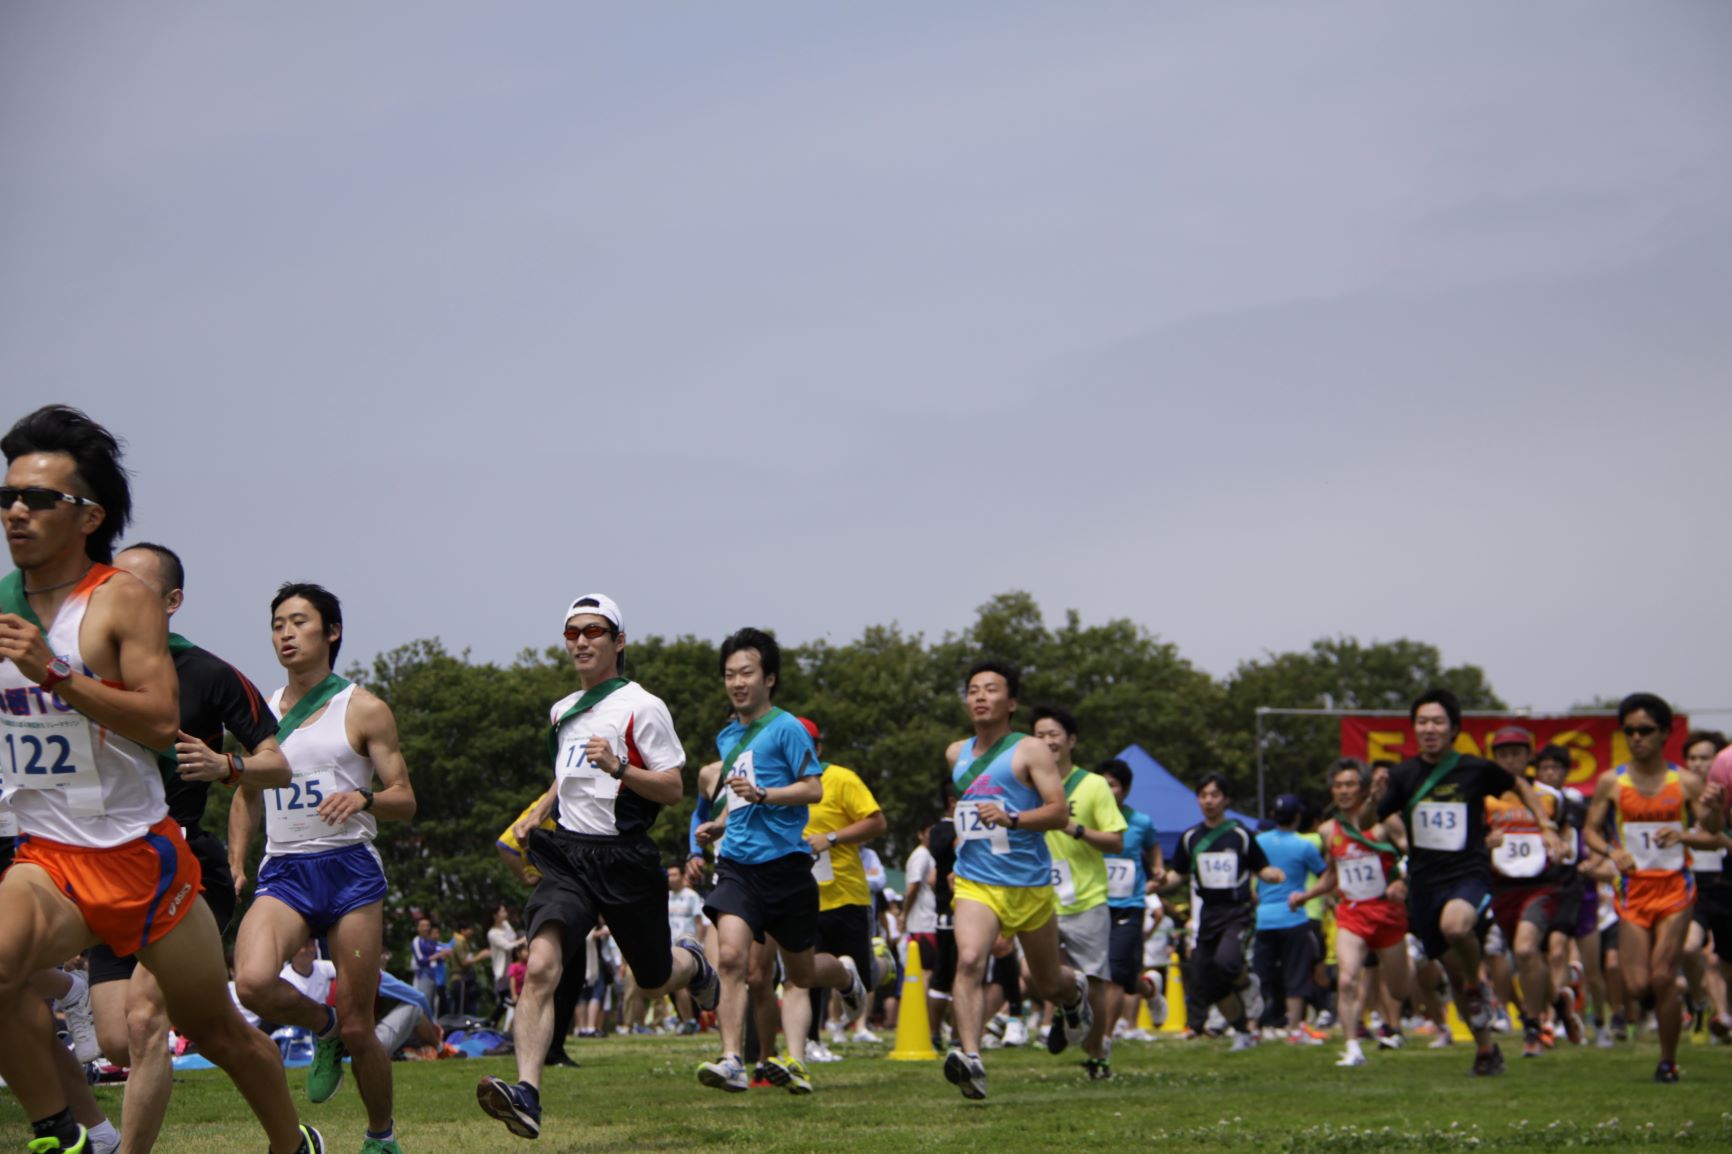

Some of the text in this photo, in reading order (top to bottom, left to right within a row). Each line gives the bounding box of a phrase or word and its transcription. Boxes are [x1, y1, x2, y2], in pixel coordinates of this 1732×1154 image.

[6, 734, 76, 774] 122
[566, 744, 599, 769] 17
[272, 779, 323, 811] 125
[1419, 810, 1456, 829] 143
[1508, 842, 1531, 858] 30
[1204, 857, 1231, 873] 146
[1344, 864, 1376, 883] 112
